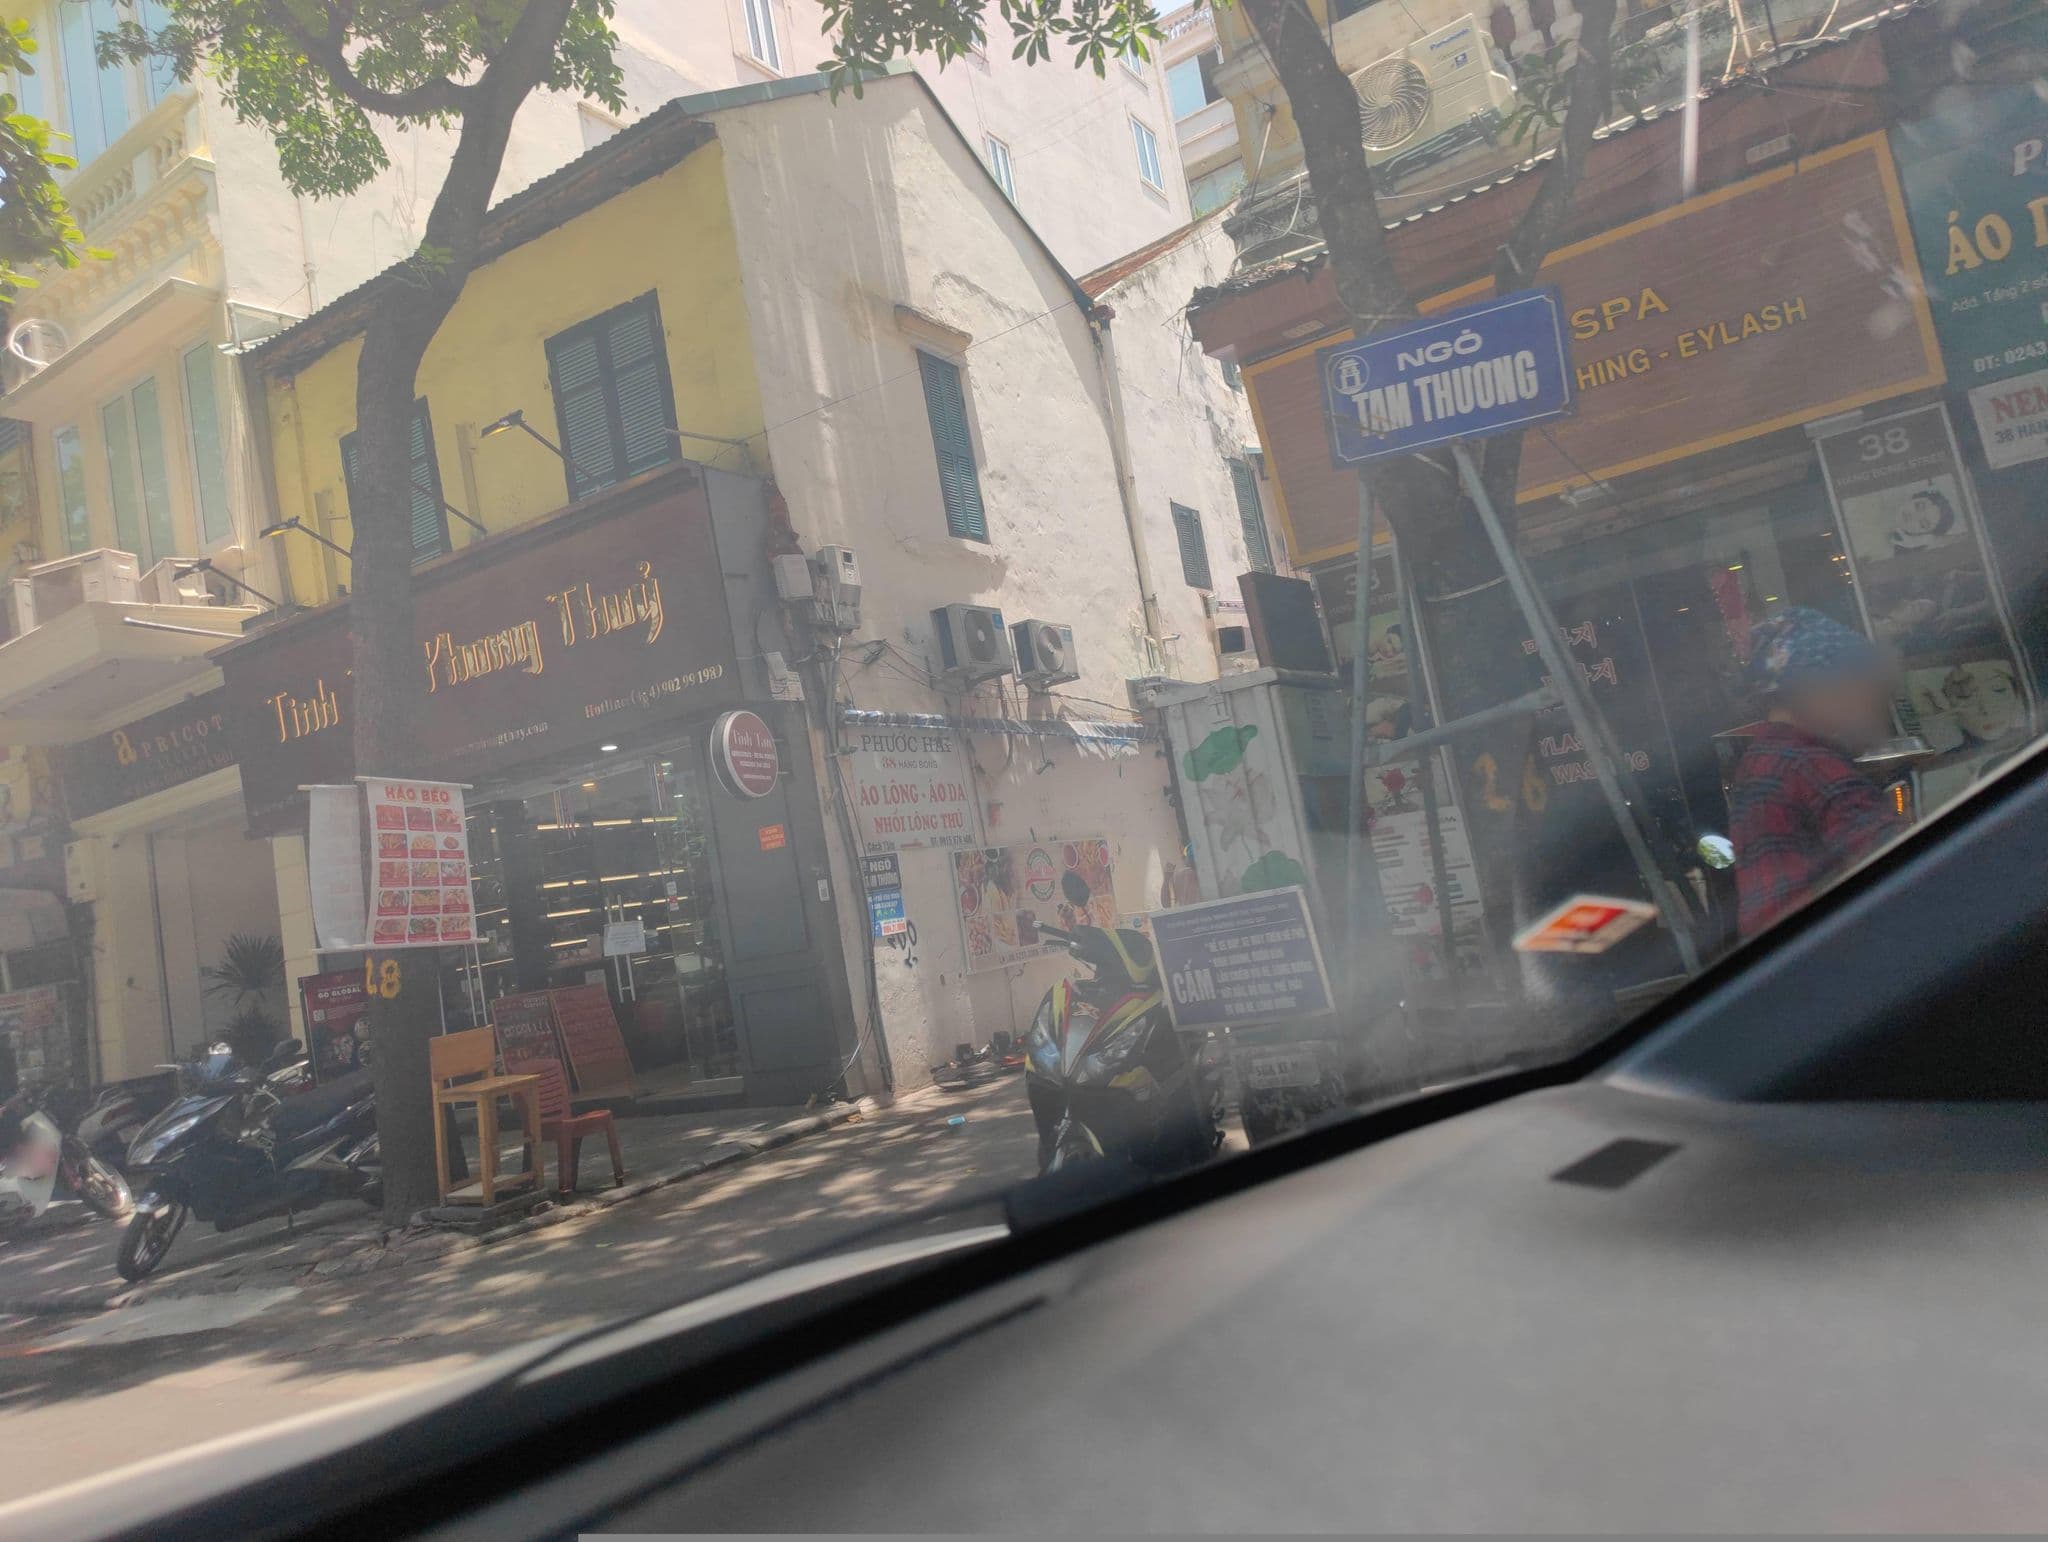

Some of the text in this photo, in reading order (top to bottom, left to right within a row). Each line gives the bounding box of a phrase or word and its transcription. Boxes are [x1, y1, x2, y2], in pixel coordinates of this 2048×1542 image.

[1945, 210, 2012, 276] ÁO
[1570, 287, 1670, 340] SPA
[1574, 348, 1651, 392] HING
[1676, 295, 1809, 359] EYLASH
[2003, 340, 2048, 365] 0243
[1857, 426, 1912, 461] 38
[860, 778, 880, 807] ÁO
[882, 778, 919, 806] LÔNG
[928, 777, 946, 804] ÁO
[947, 783, 966, 802] DA
[1171, 957, 1217, 1005] CẤM
